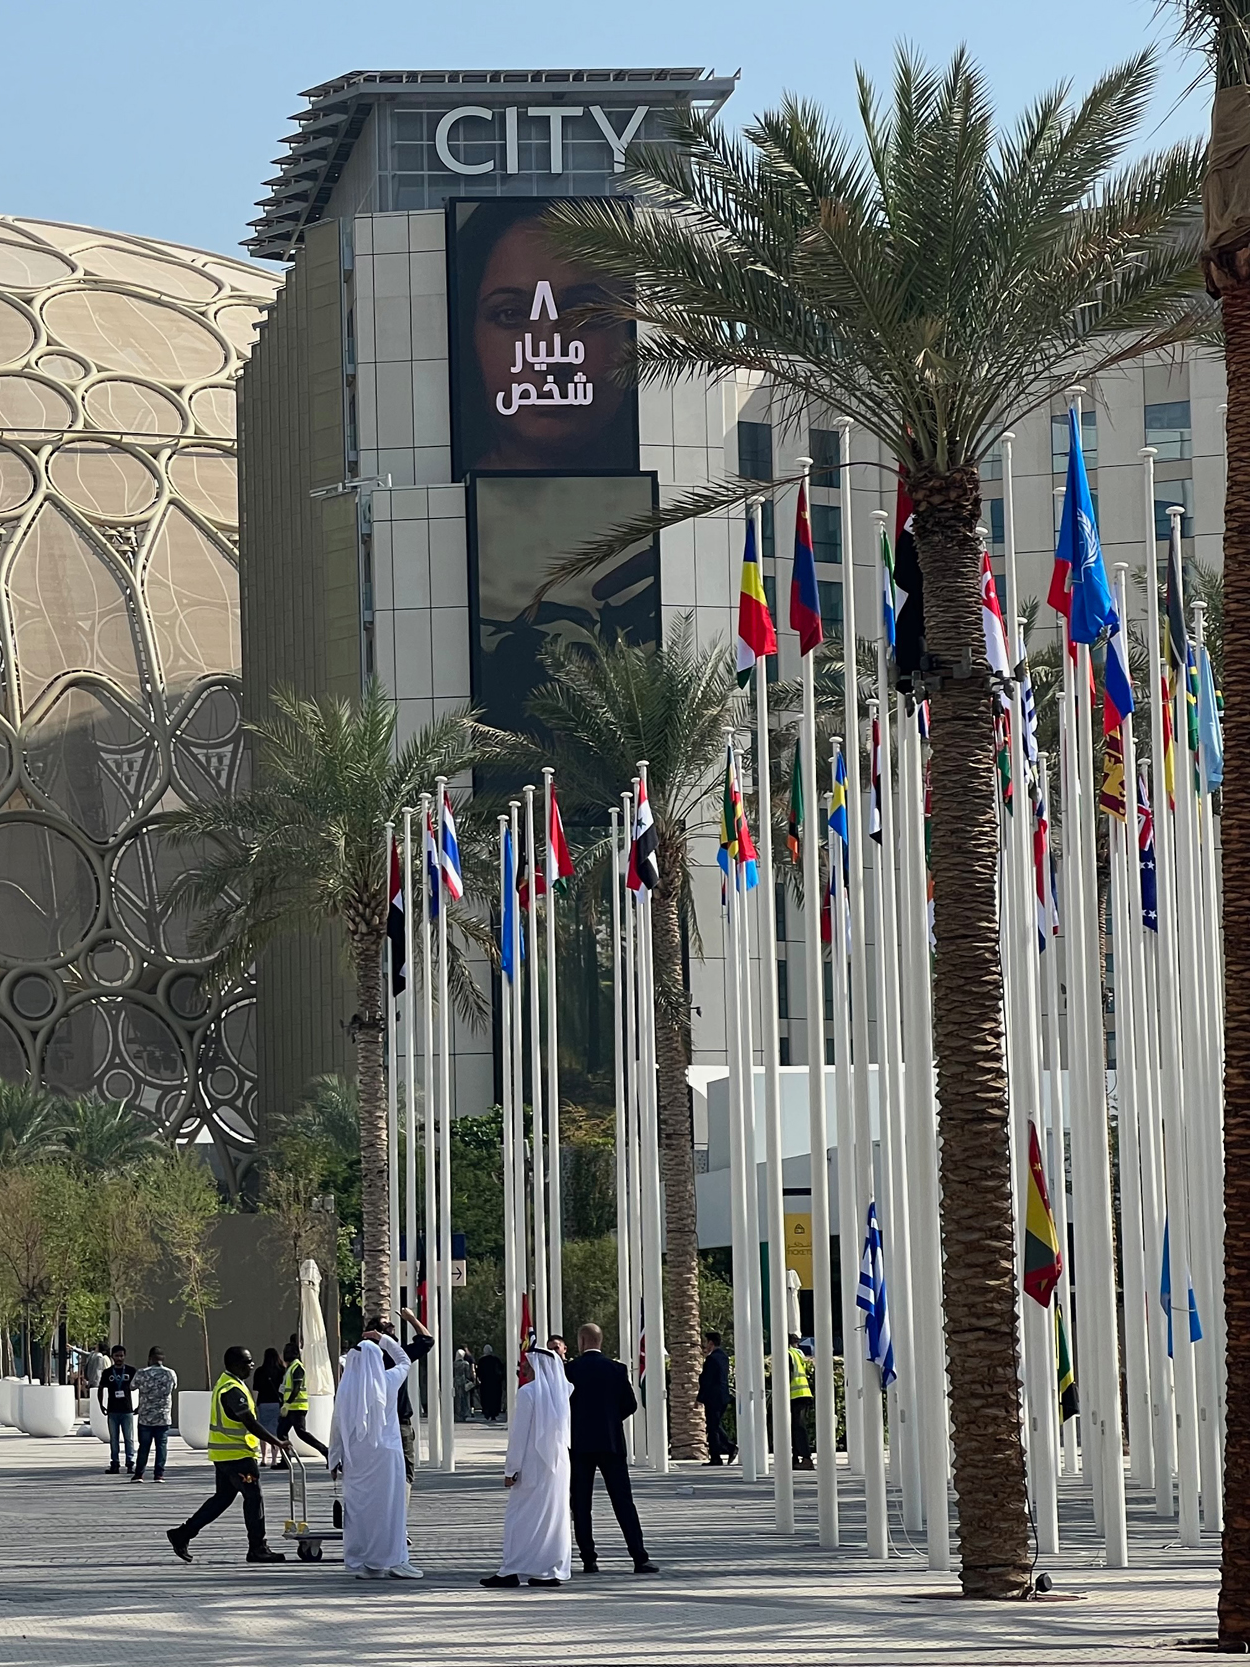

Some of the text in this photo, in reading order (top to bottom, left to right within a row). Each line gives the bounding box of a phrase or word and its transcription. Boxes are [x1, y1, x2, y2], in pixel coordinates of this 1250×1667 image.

[435, 105, 650, 175] CITY
[530, 281, 558, 320] ٨
[511, 332, 585, 373] مليار
[496, 372, 593, 415] شخص
